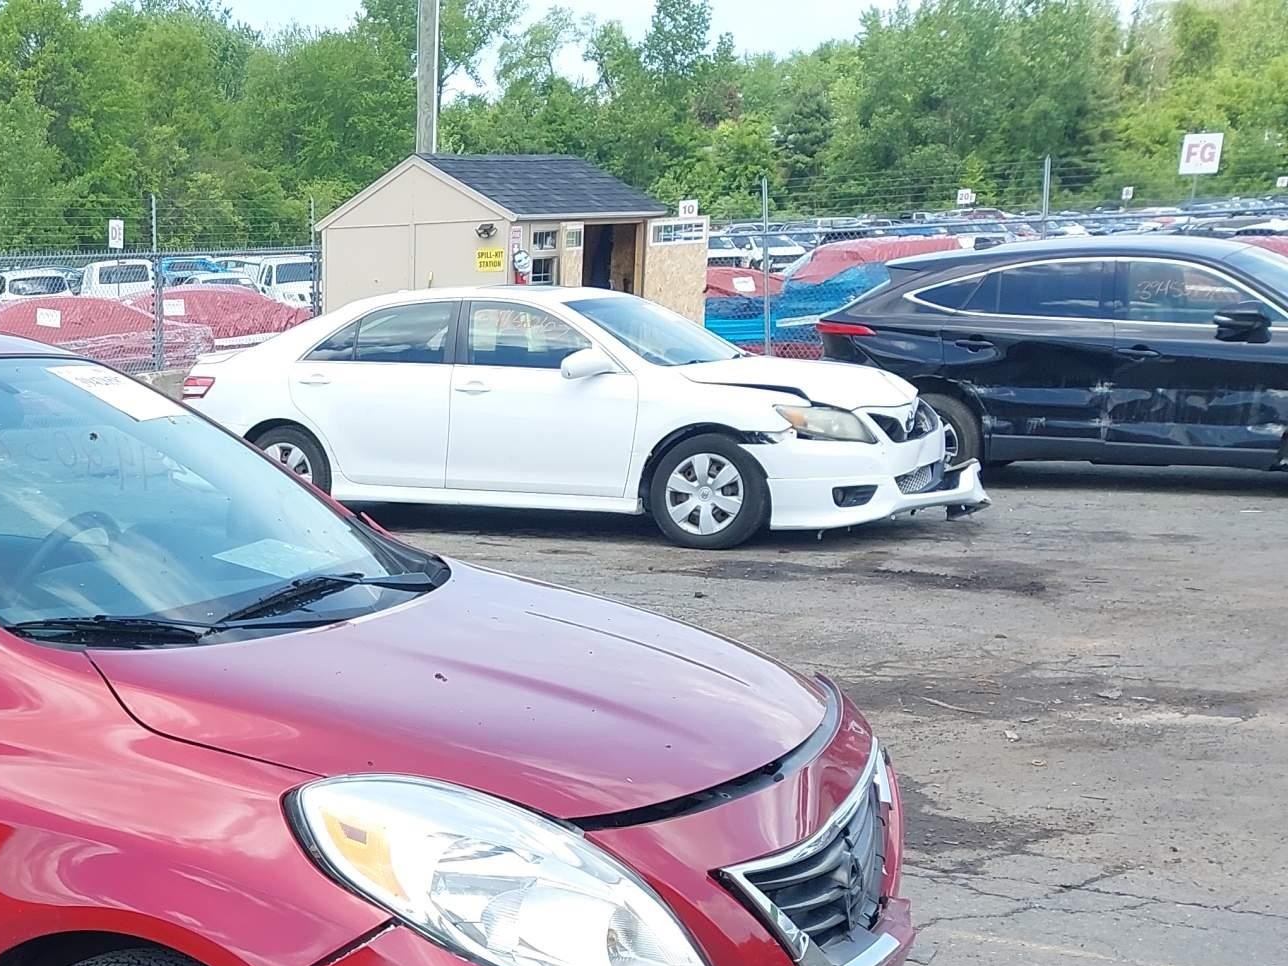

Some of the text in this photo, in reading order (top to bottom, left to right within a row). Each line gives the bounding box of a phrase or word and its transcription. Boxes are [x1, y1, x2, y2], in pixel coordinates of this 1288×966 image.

[1185, 142, 1216, 164] FG
[682, 204, 695, 215] 10
[111, 226, 122, 241] DE
[477, 251, 504, 259] SPILL-KIT
[479, 260, 501, 268] STATION
